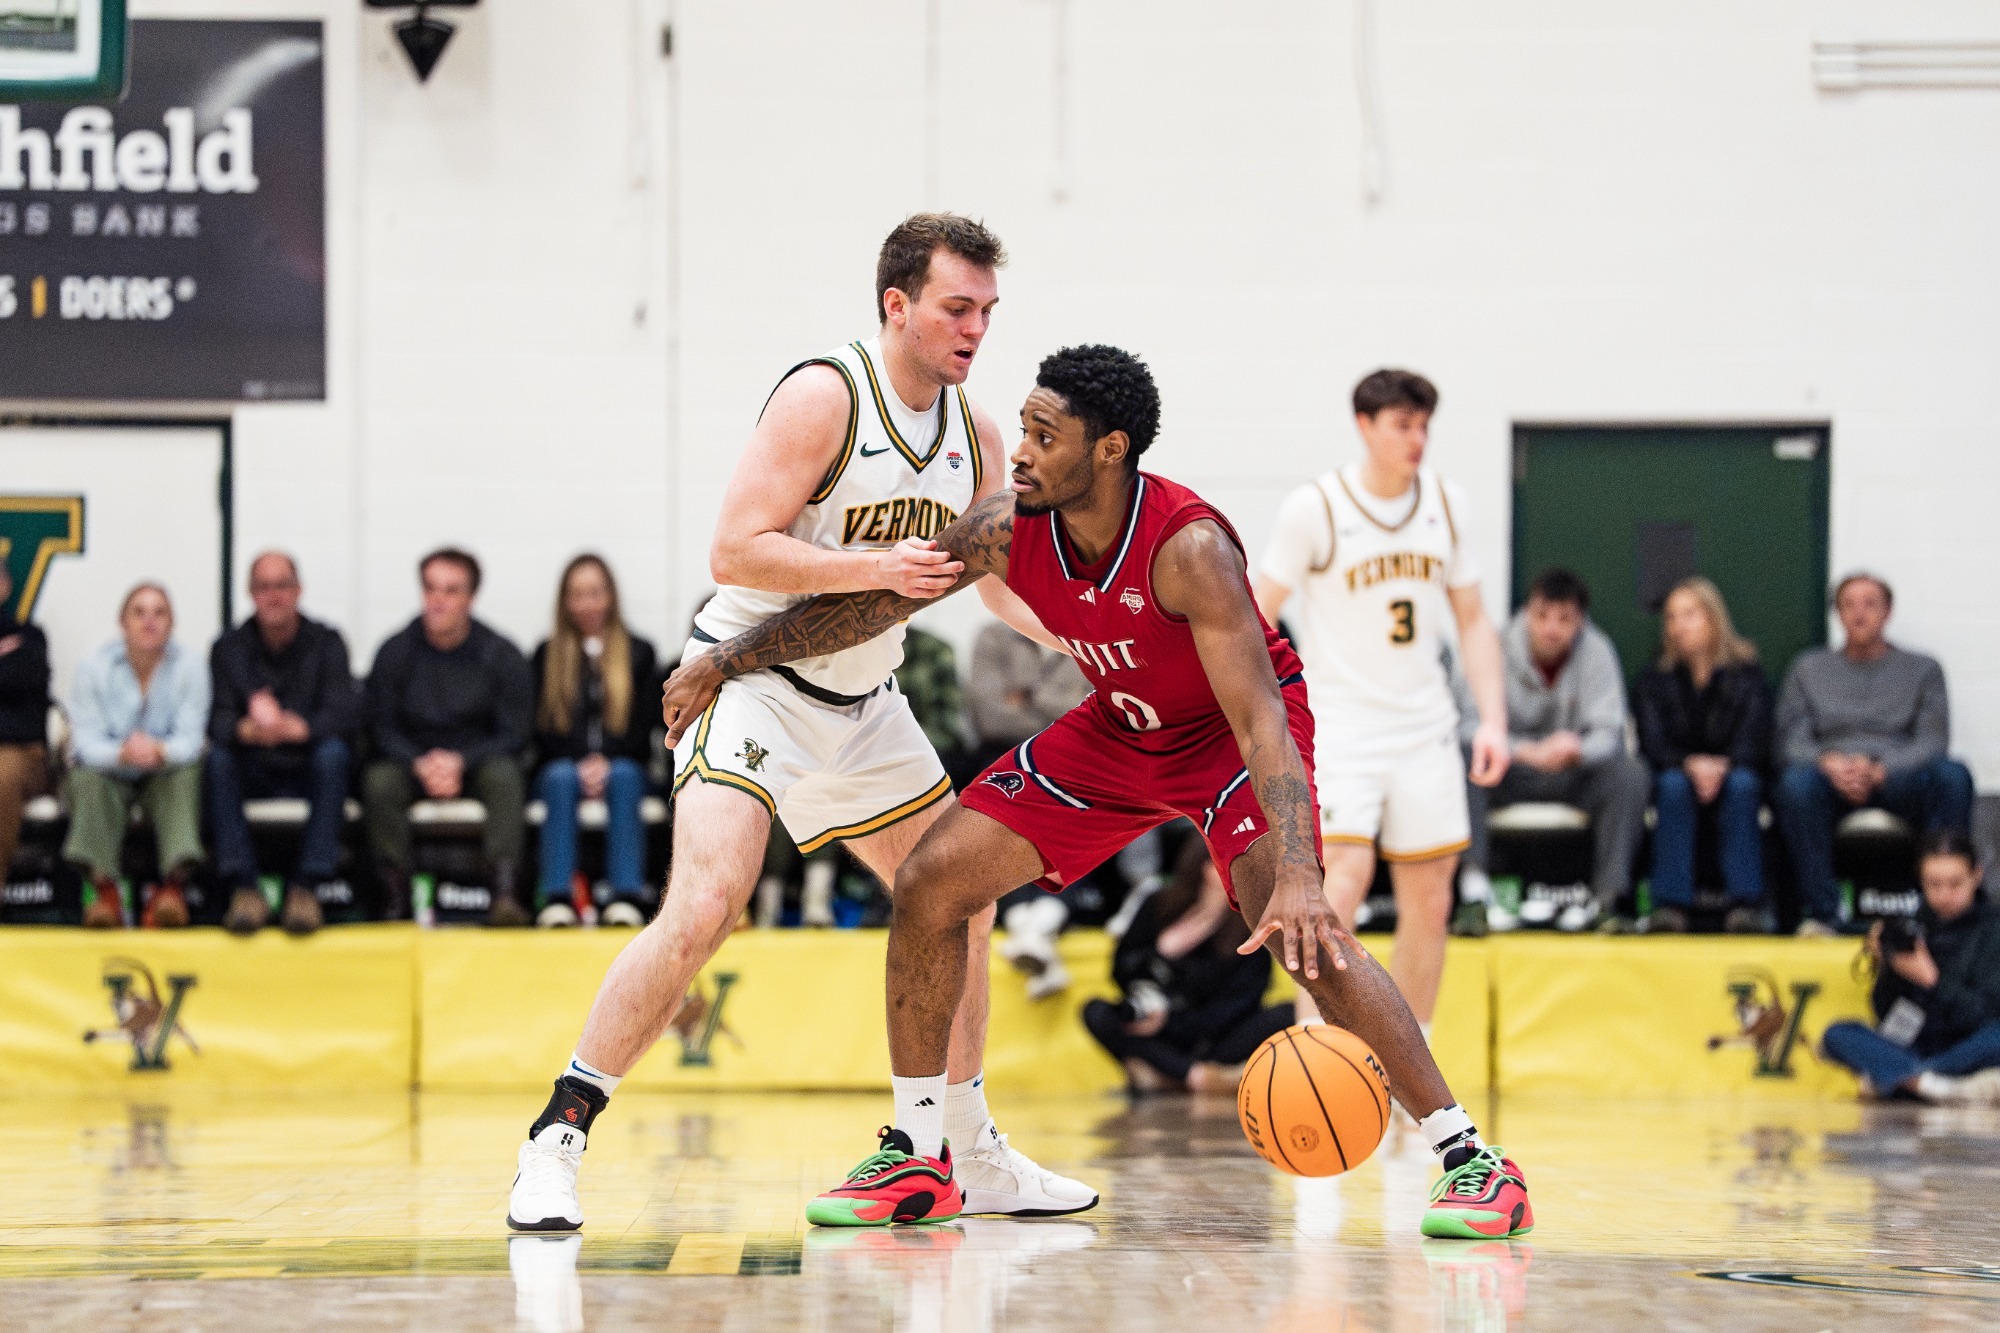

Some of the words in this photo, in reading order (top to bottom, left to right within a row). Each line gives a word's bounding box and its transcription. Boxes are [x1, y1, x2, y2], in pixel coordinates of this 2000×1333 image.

[0, 105, 259, 193] hfield
[71, 203, 200, 237] BANK
[1388, 599, 1416, 646] 3
[1110, 691, 1162, 733] 0
